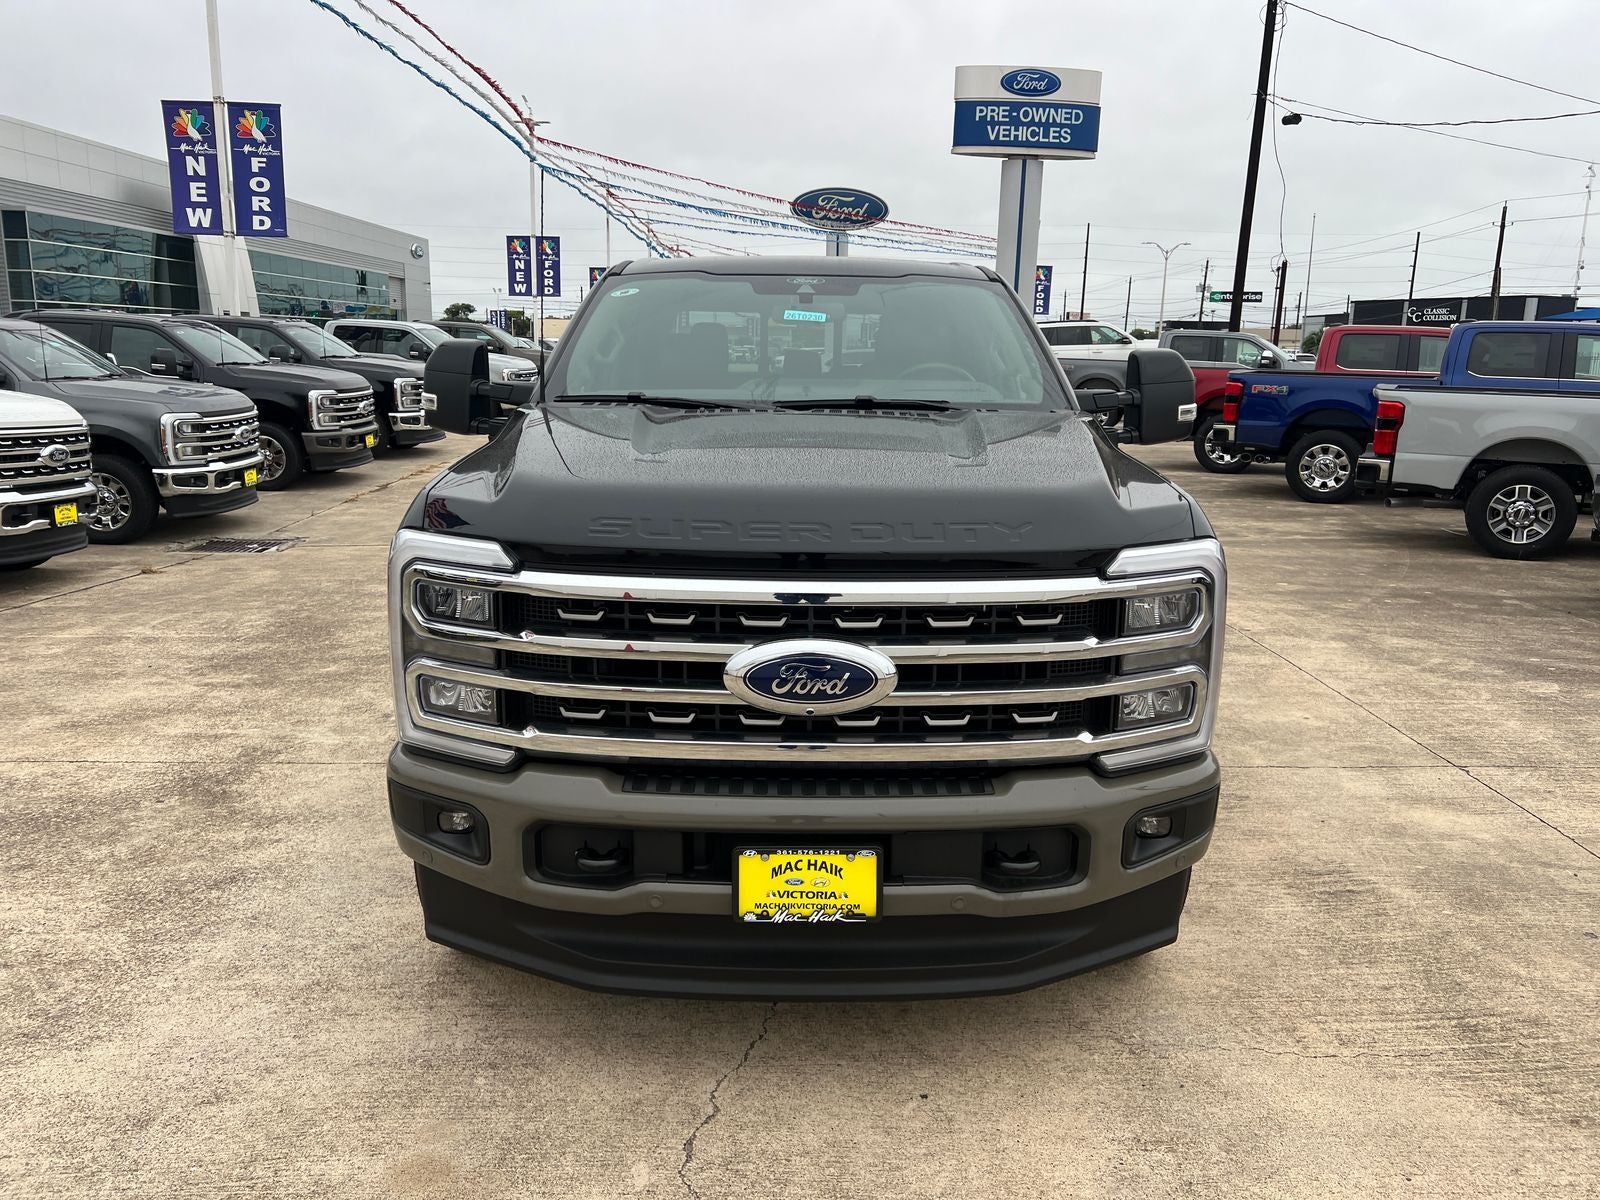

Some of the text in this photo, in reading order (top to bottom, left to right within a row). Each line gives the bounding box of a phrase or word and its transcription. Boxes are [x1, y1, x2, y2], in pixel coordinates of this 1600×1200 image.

[1013, 72, 1049, 90] Ford
[976, 106, 1083, 124] PRE-OWNED
[987, 125, 1071, 143] VEHICLES
[185, 156, 212, 228] NEW
[249, 157, 272, 231] FORD
[811, 194, 869, 220] Ford
[514, 260, 526, 293] NEW
[544, 261, 554, 294] FORD
[1035, 285, 1045, 313] FORD
[785, 311, 823, 321] 26T0230
[1251, 384, 1289, 393] FX4
[588, 516, 1033, 543] SUPER DUTY
[771, 663, 850, 695] Ford
[771, 859, 843, 880] MAC HAIK
[777, 890, 838, 900] VICTORIA
[771, 909, 846, 923] Mac Haik
